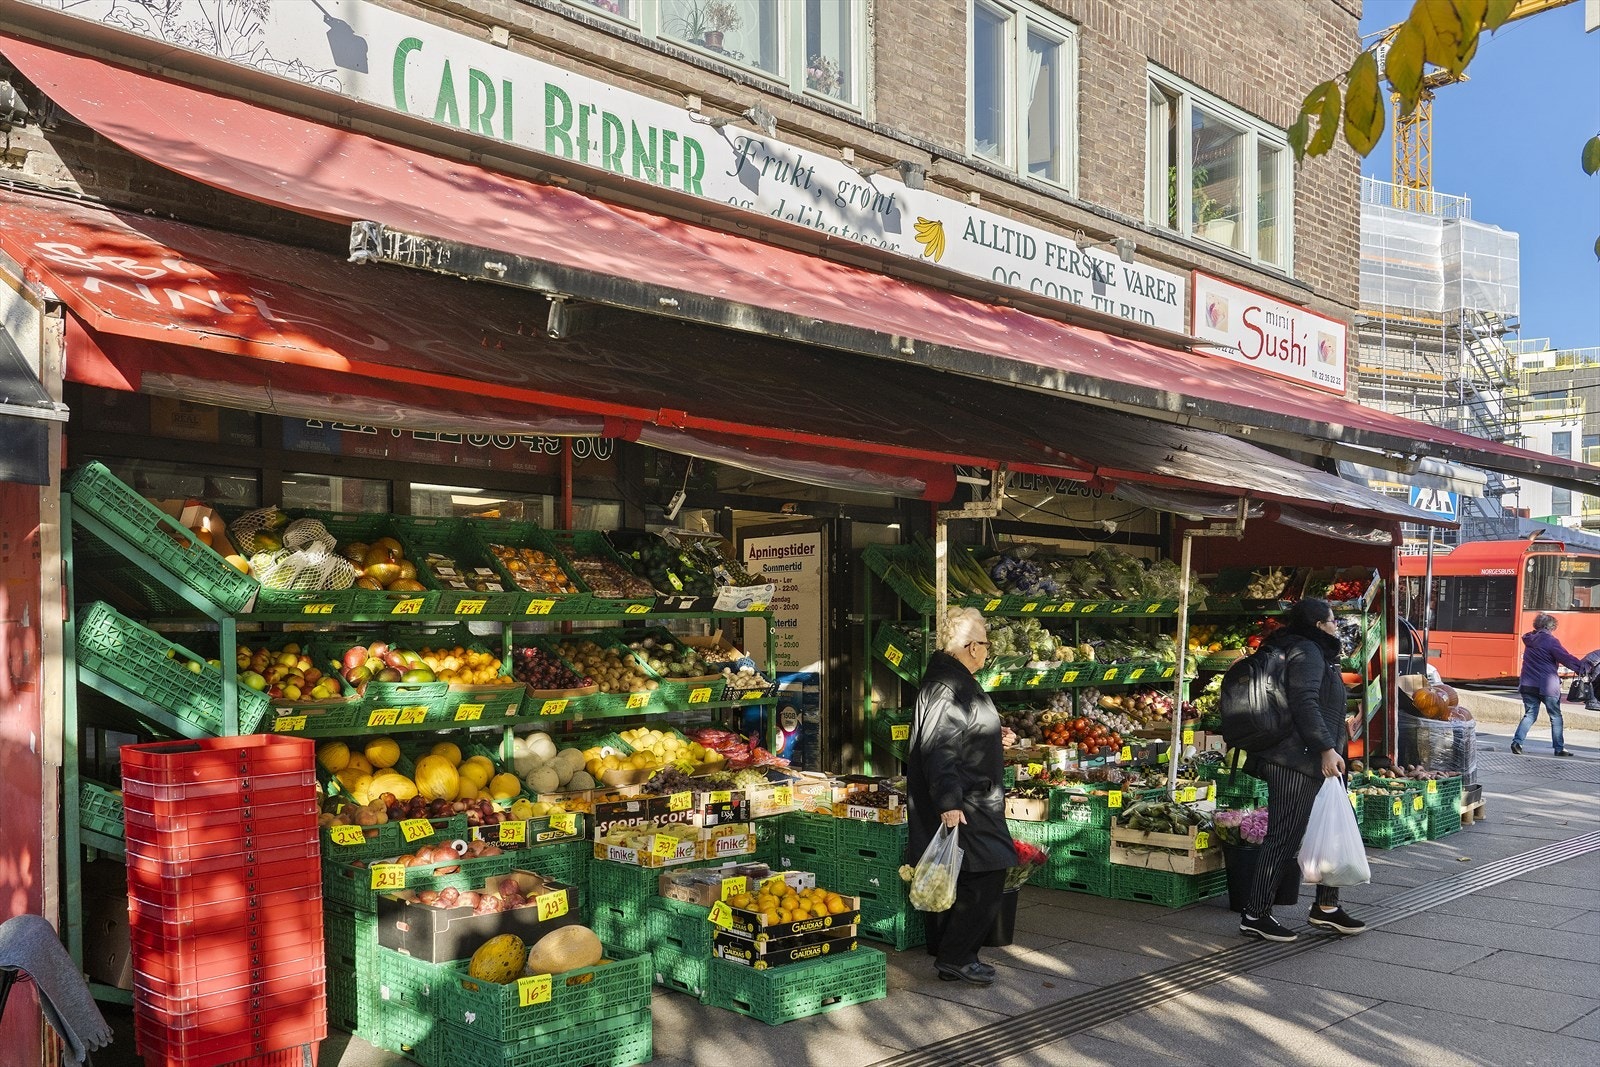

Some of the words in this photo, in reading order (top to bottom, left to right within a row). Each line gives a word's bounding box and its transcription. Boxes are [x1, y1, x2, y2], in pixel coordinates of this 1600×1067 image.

[544, 82, 706, 196] BERNER
[725, 135, 823, 198] Frukt,
[837, 179, 896, 215] grønt
[962, 216, 1037, 261] ALLTID
[1045, 241, 1117, 287] FERSKE
[1123, 267, 1178, 306] VARER
[1265, 307, 1289, 330] mini
[1238, 306, 1308, 367] Sushi
[749, 543, 815, 560] Åpningstider
[763, 562, 802, 572] Sommertid
[775, 618, 797, 627] tertid
[653, 809, 695, 825] SCOPE
[849, 807, 876, 819] finike
[716, 836, 747, 853] finike
[609, 847, 636, 861] finike
[791, 918, 823, 933] GAUDIAS
[722, 945, 745, 959] GAUDIAS
[790, 946, 821, 960] GAUDIAS
